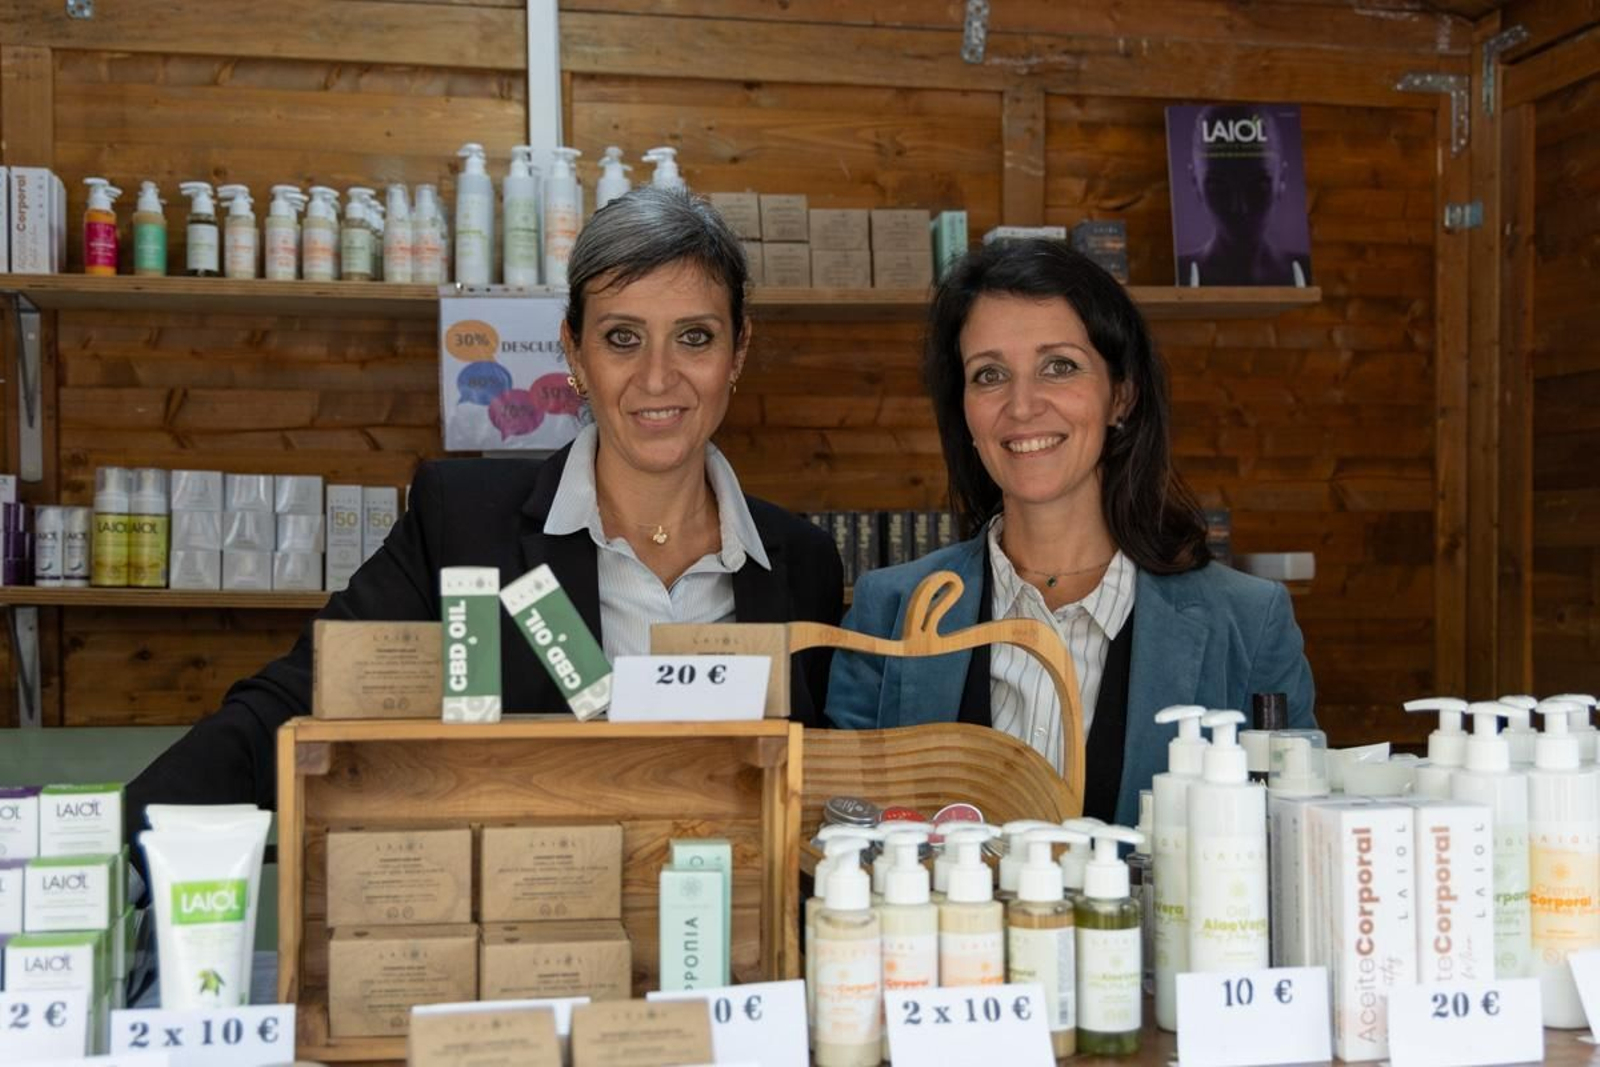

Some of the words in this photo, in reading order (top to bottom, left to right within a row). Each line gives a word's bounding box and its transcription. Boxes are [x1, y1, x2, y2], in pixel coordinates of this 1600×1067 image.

[1202, 117, 1268, 142] LAIOL
[455, 332, 490, 348] 30%
[335, 511, 358, 527] 50
[447, 599, 467, 639] OIL
[524, 607, 554, 646] OIL
[449, 642, 468, 692] CBD
[546, 645, 582, 690] CBD
[656, 663, 697, 685] 20
[707, 663, 728, 685] €
[56, 801, 102, 818] LAIOL
[42, 873, 89, 891] LAIOL
[181, 889, 241, 914] LAIOL
[1530, 893, 1592, 911] Corporal
[24, 954, 72, 972] LAIOL
[1221, 977, 1253, 1007] 10
[1274, 978, 1293, 1004] €
[1431, 991, 1470, 1018] 20
[1481, 990, 1501, 1016] €
[44, 1000, 67, 1028] €
[714, 997, 732, 1024] 0
[743, 995, 763, 1021] €
[902, 1000, 922, 1025] 2
[933, 1005, 952, 1024] x
[965, 996, 1001, 1023] 10
[1012, 995, 1032, 1021] €
[129, 1022, 150, 1048] 2
[163, 1027, 183, 1047] x
[202, 1018, 243, 1046] 10
[257, 1016, 280, 1044] €
